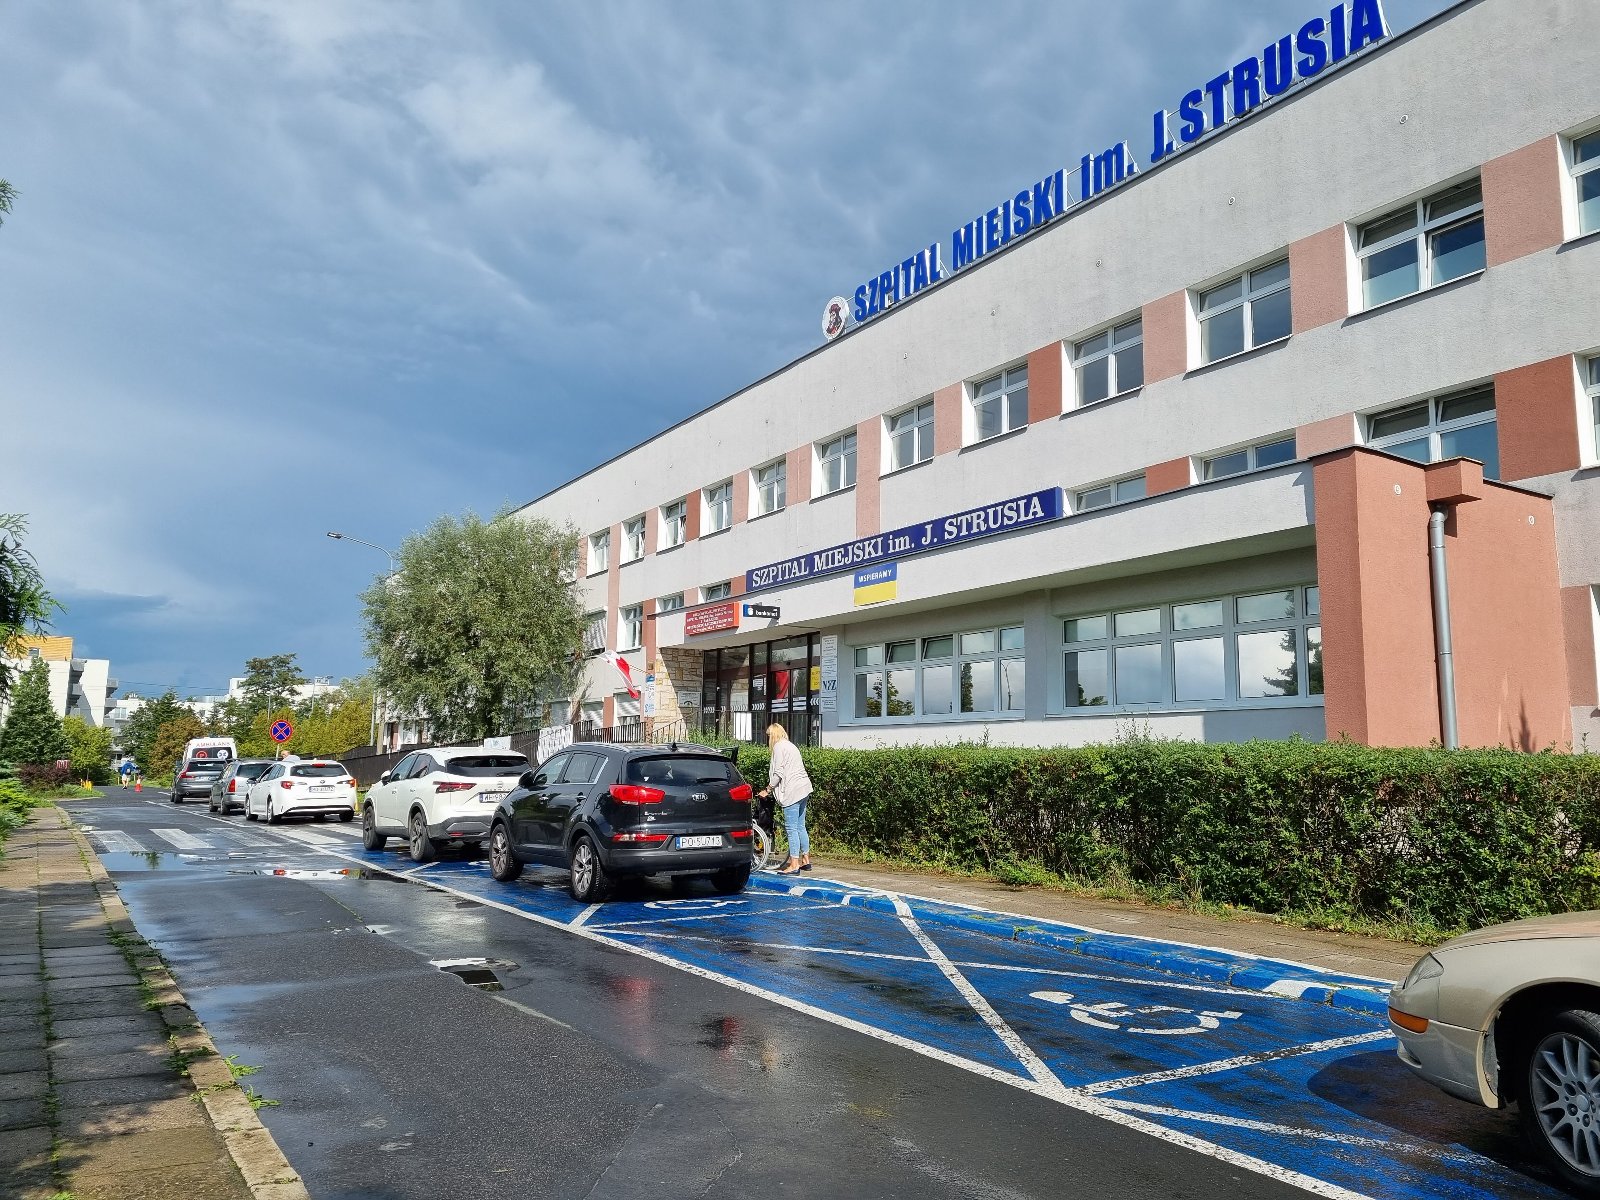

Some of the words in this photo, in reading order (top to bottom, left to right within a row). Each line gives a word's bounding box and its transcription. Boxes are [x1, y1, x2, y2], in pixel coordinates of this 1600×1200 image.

[854, 243, 943, 323] SZPITAL
[952, 169, 1067, 272] MIEJSKI
[1080, 141, 1137, 201] im.
[1179, 0, 1388, 144] STRUSIA
[752, 558, 809, 588] SZPITAL
[813, 536, 884, 573] MIEJSKI
[887, 534, 915, 554] im.
[921, 524, 938, 546] J.
[944, 496, 1045, 540] STRUSIA
